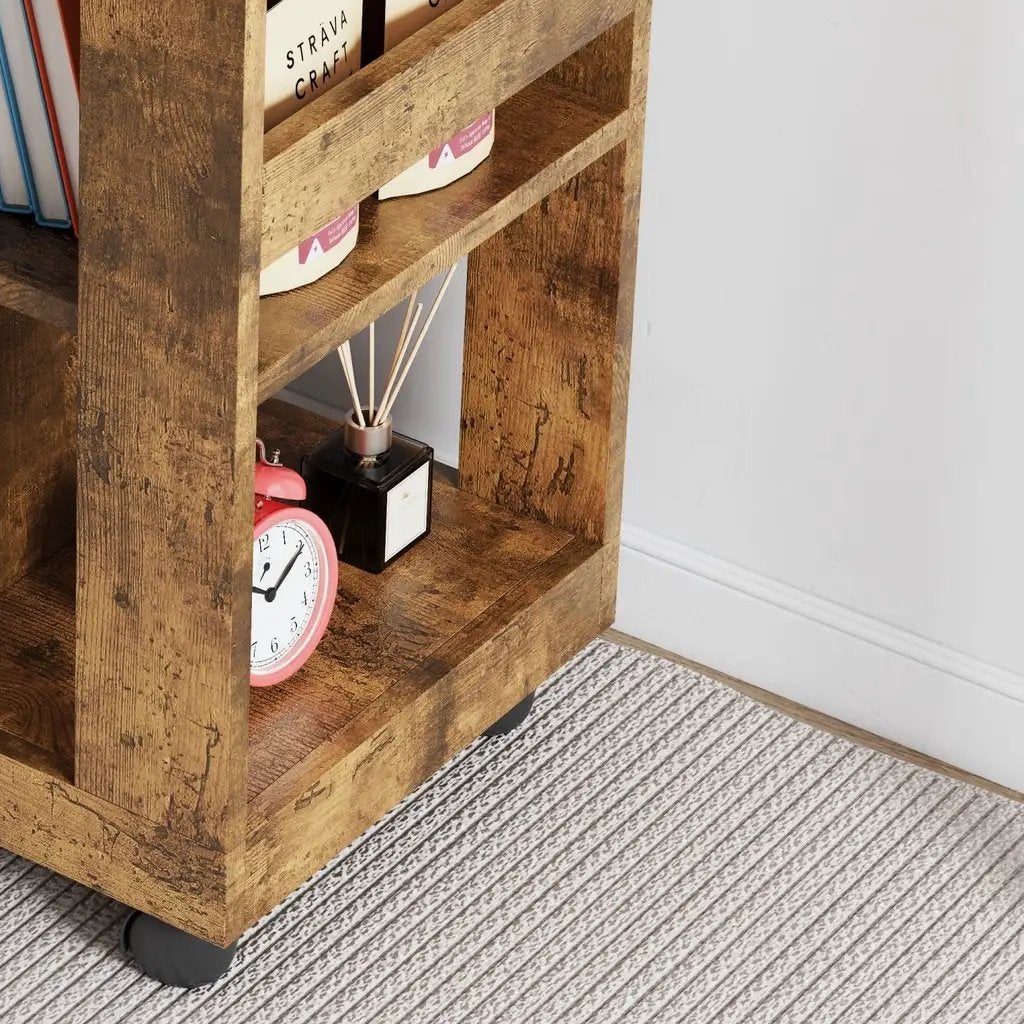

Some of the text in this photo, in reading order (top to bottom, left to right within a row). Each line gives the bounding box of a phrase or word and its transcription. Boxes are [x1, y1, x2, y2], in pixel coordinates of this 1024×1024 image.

[285, 9, 349, 70] STRÄVA
[294, 41, 349, 100] CRAFT
[258, 533, 270, 553] 12
[282, 530, 287, 545] 1
[303, 561, 312, 578] 3
[301, 591, 307, 606] 4
[290, 616, 298, 633] 5
[251, 641, 258, 658] 7
[270, 636, 279, 654] 6
